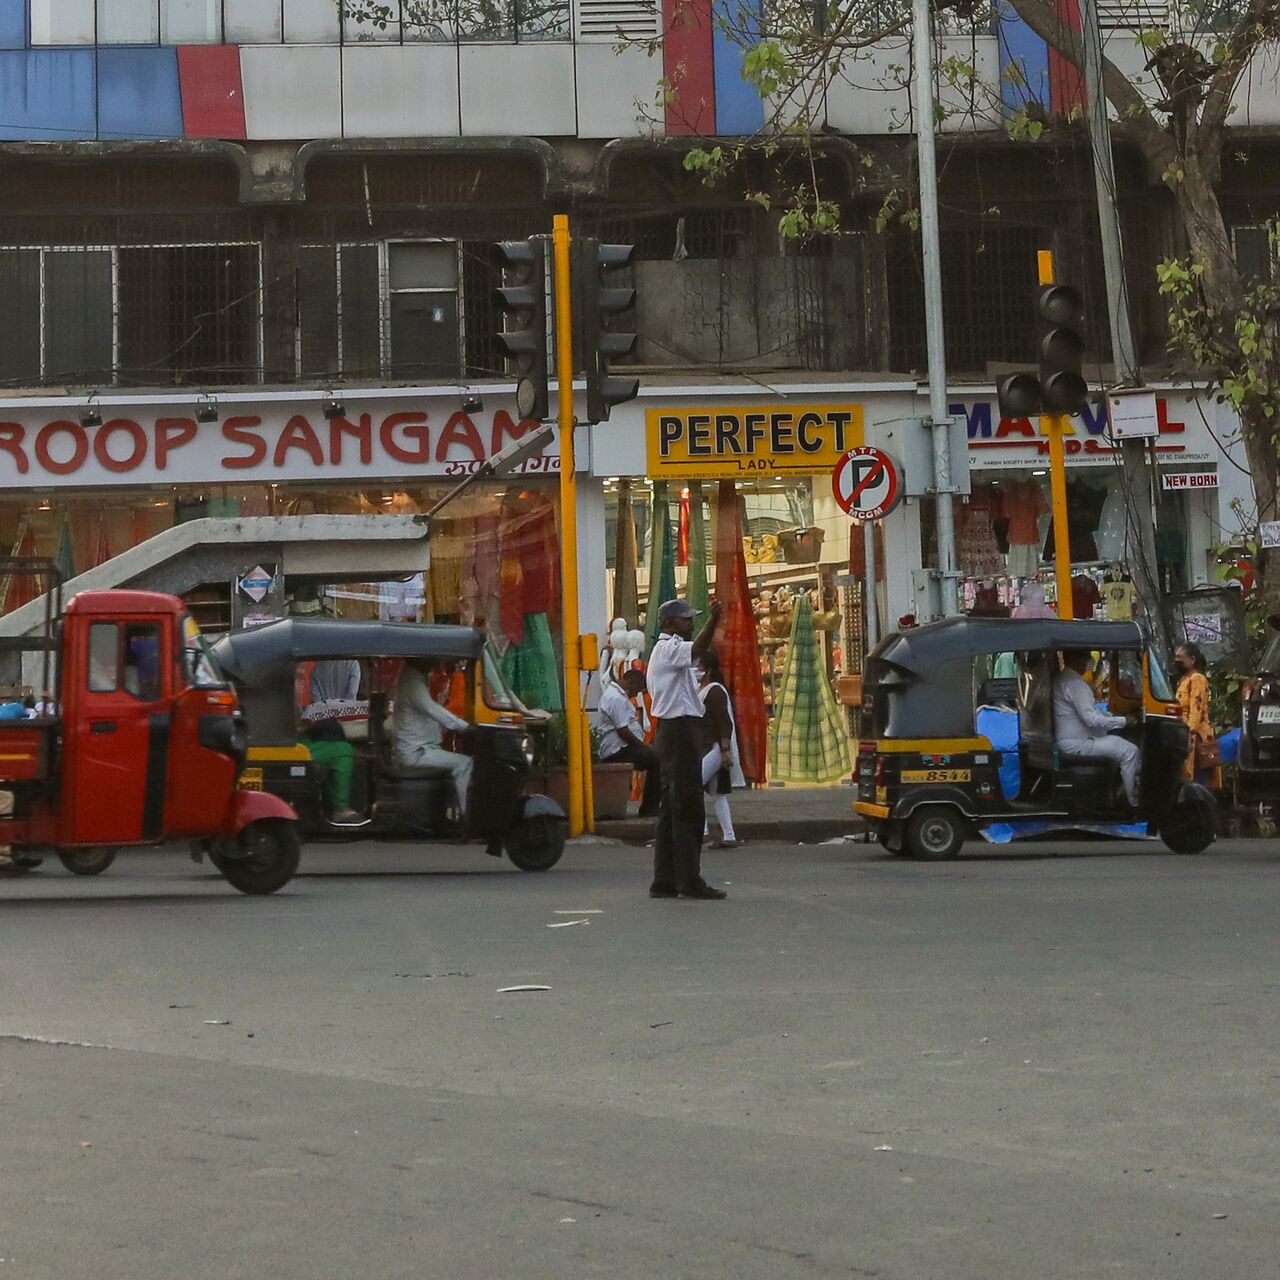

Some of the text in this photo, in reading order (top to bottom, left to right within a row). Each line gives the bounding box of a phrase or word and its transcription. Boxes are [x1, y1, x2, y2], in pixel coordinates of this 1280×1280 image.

[221, 409, 543, 469] SANGAM
[658, 411, 853, 458] PERFECT
[1037, 439, 1099, 455] KDS
[738, 458, 776, 470] LADY
[1166, 474, 1217, 487] NEW BORN
[848, 506, 883, 519] MCGM
[926, 770, 970, 782] 8544
